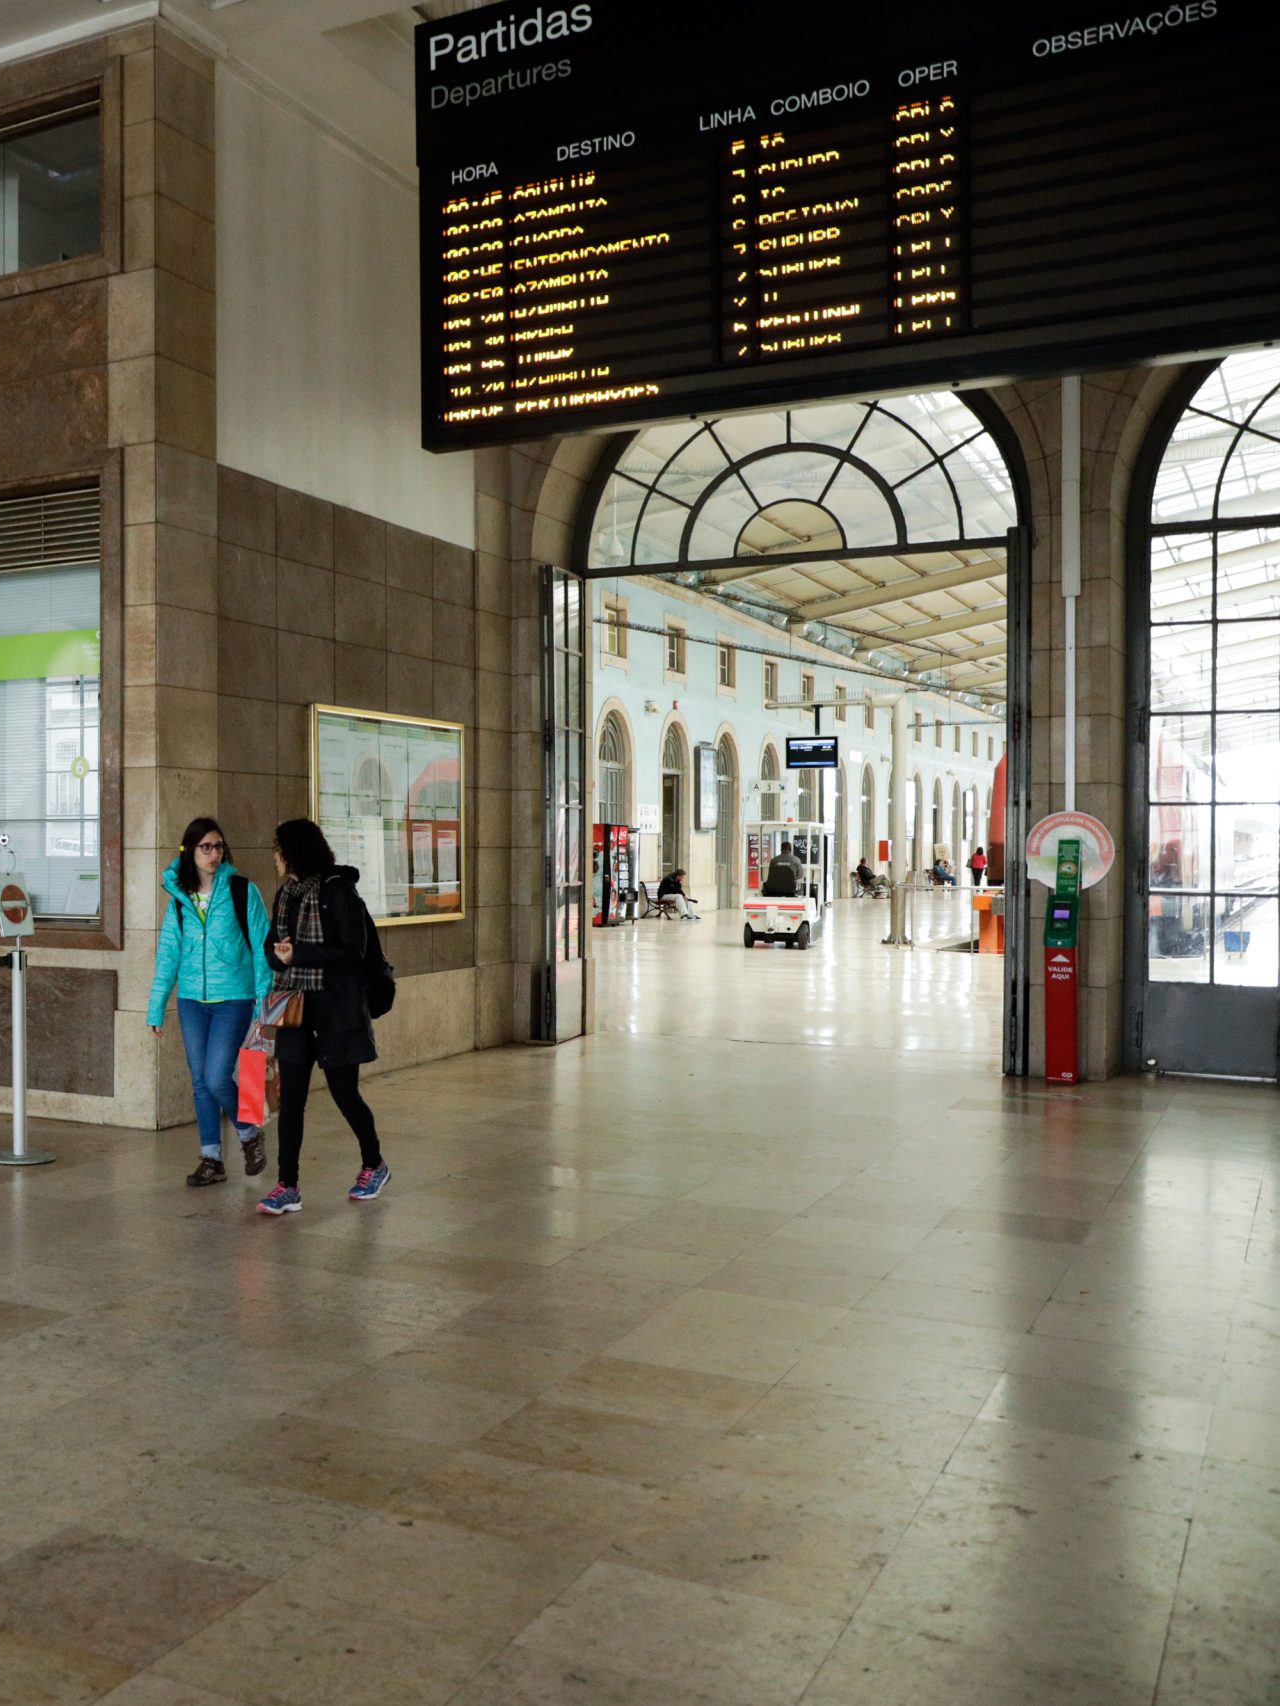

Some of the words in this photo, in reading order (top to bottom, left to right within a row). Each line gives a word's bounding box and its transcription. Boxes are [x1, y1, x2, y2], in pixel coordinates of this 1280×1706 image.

[429, 3, 593, 71] Partidas
[1032, 0, 1218, 57] OBSERVAÇÕES
[431, 58, 572, 109] Departures
[451, 162, 499, 185] HORA
[557, 131, 635, 162] DESTINO
[699, 105, 756, 132] LINHA
[770, 79, 869, 117] COMBOIO
[898, 60, 958, 88] OPER
[76, 760, 84, 774] 6
